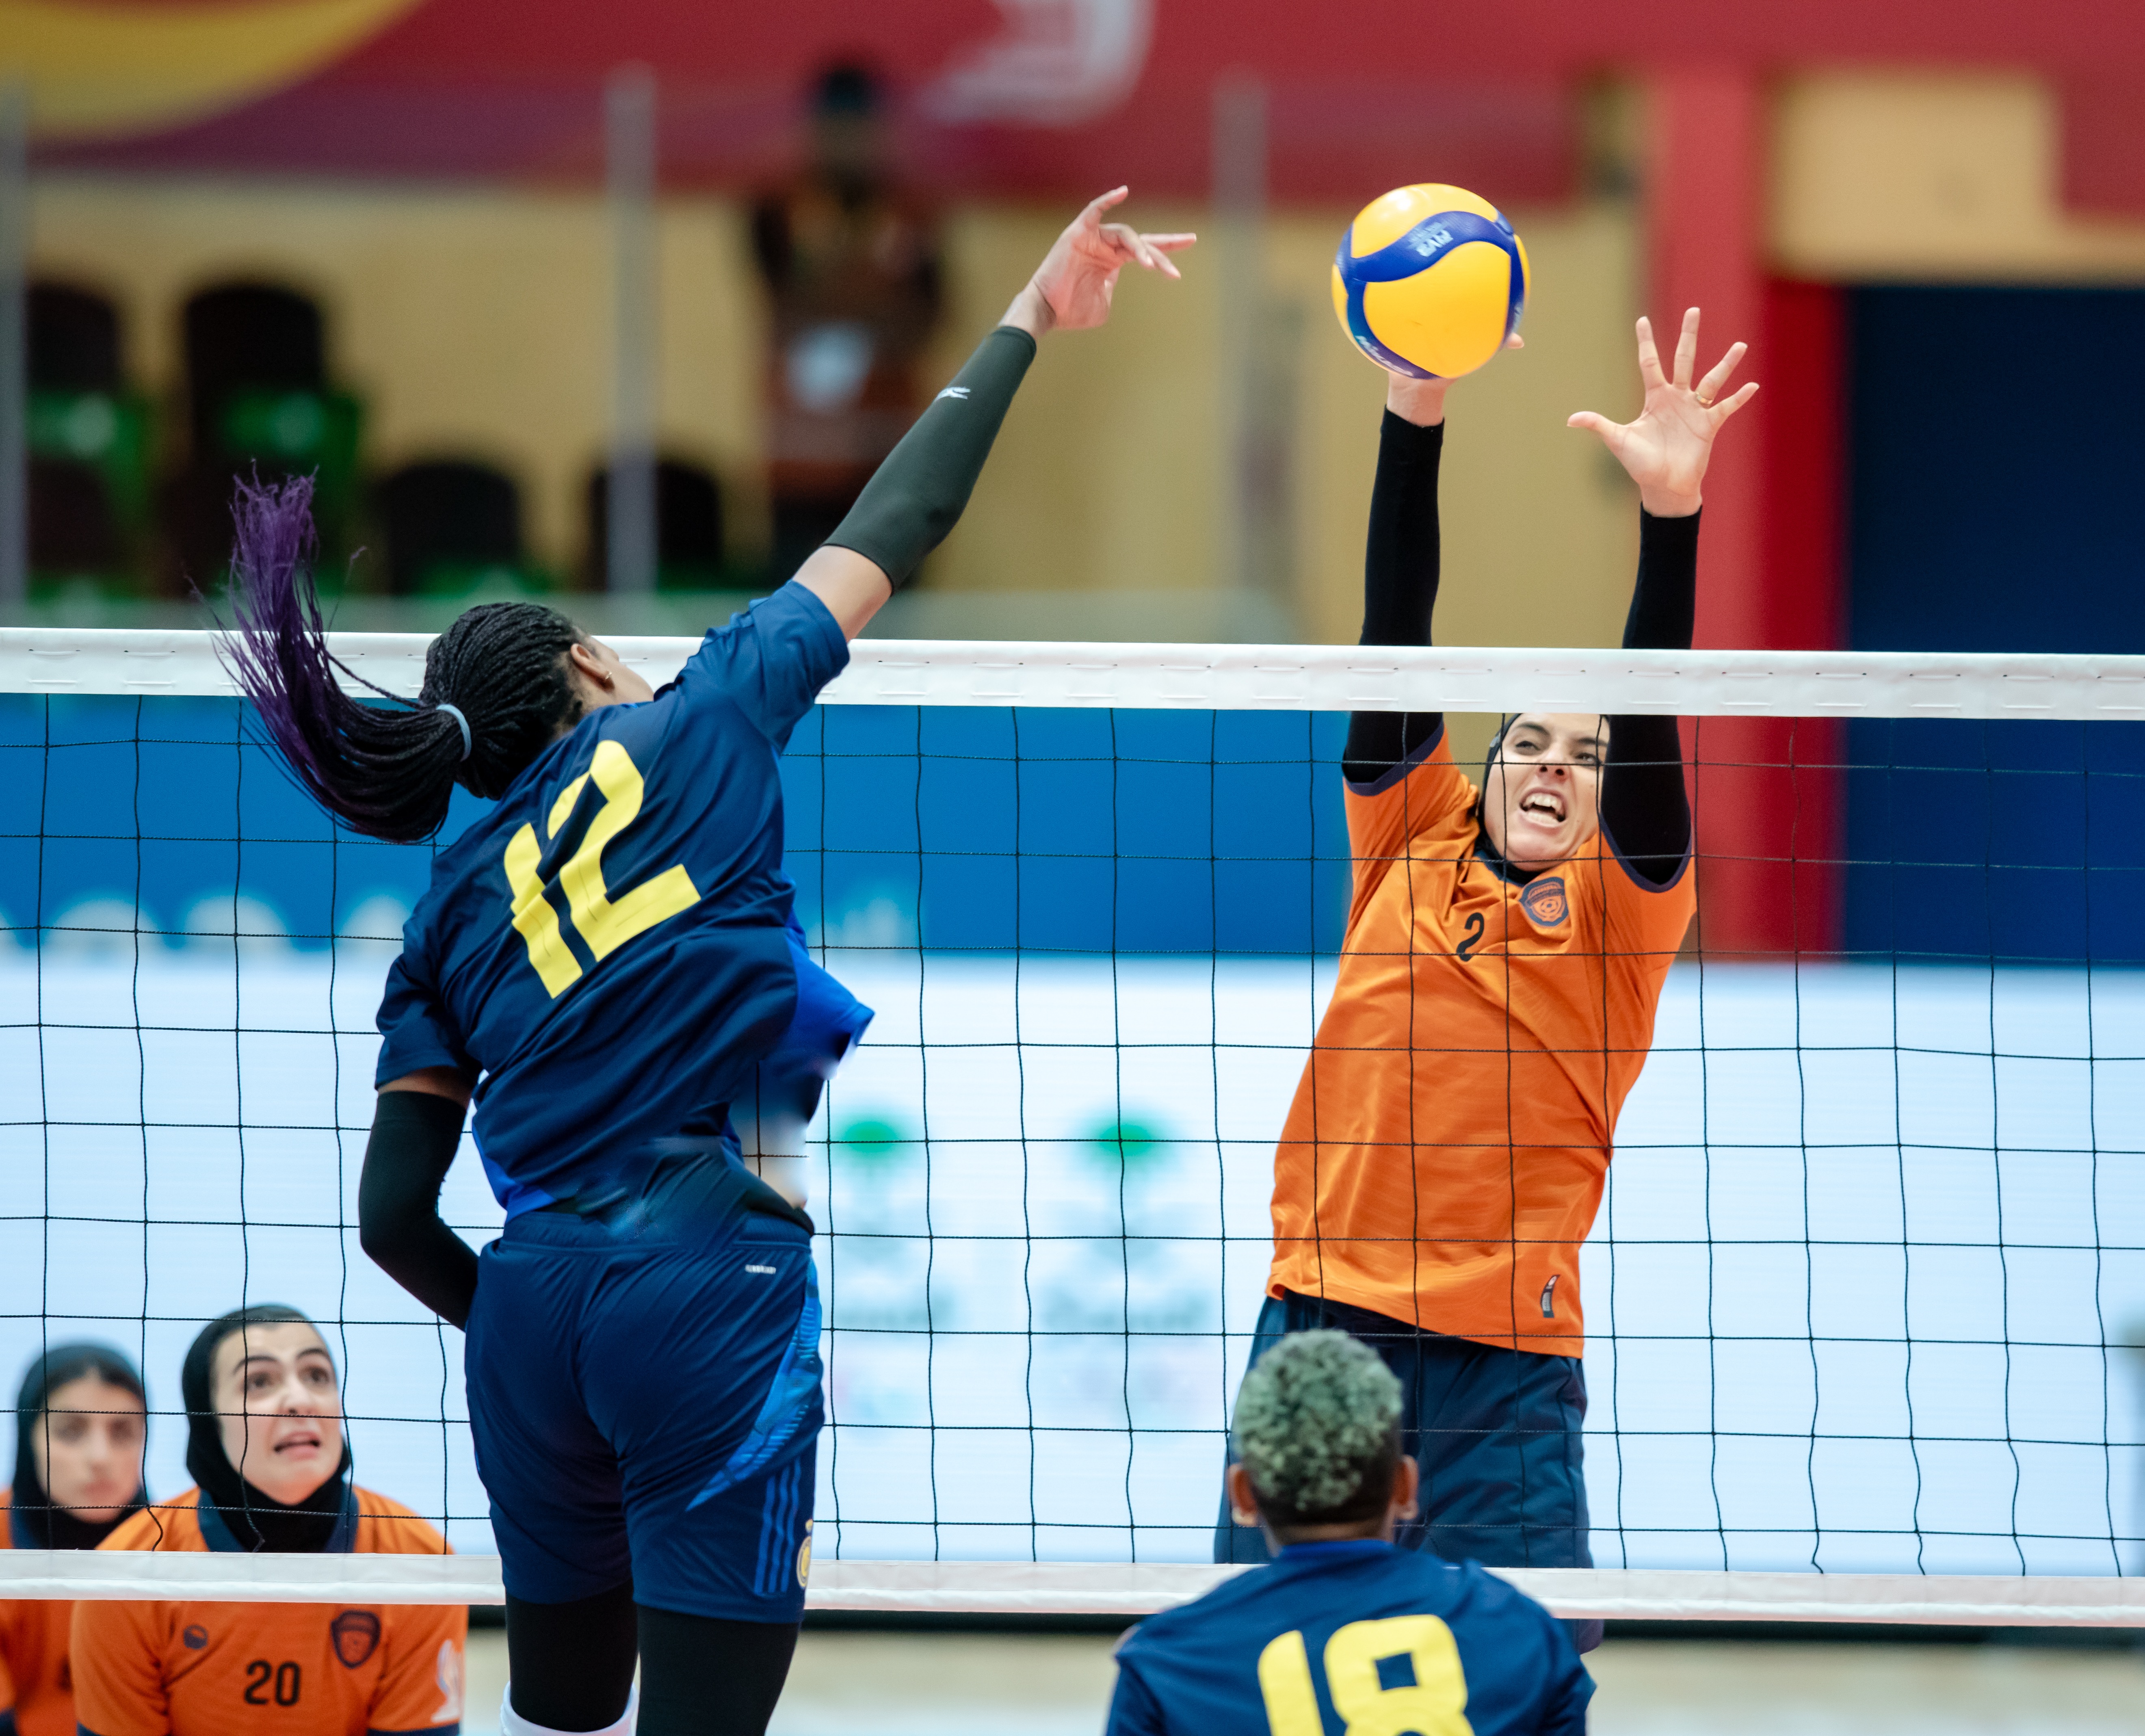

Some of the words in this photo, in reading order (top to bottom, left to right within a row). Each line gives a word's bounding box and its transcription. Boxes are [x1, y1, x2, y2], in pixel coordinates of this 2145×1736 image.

[504, 739, 701, 999] 12
[1456, 912, 1485, 962] 2
[244, 1660, 301, 1707] 20
[1257, 1613, 1476, 1736] 18
